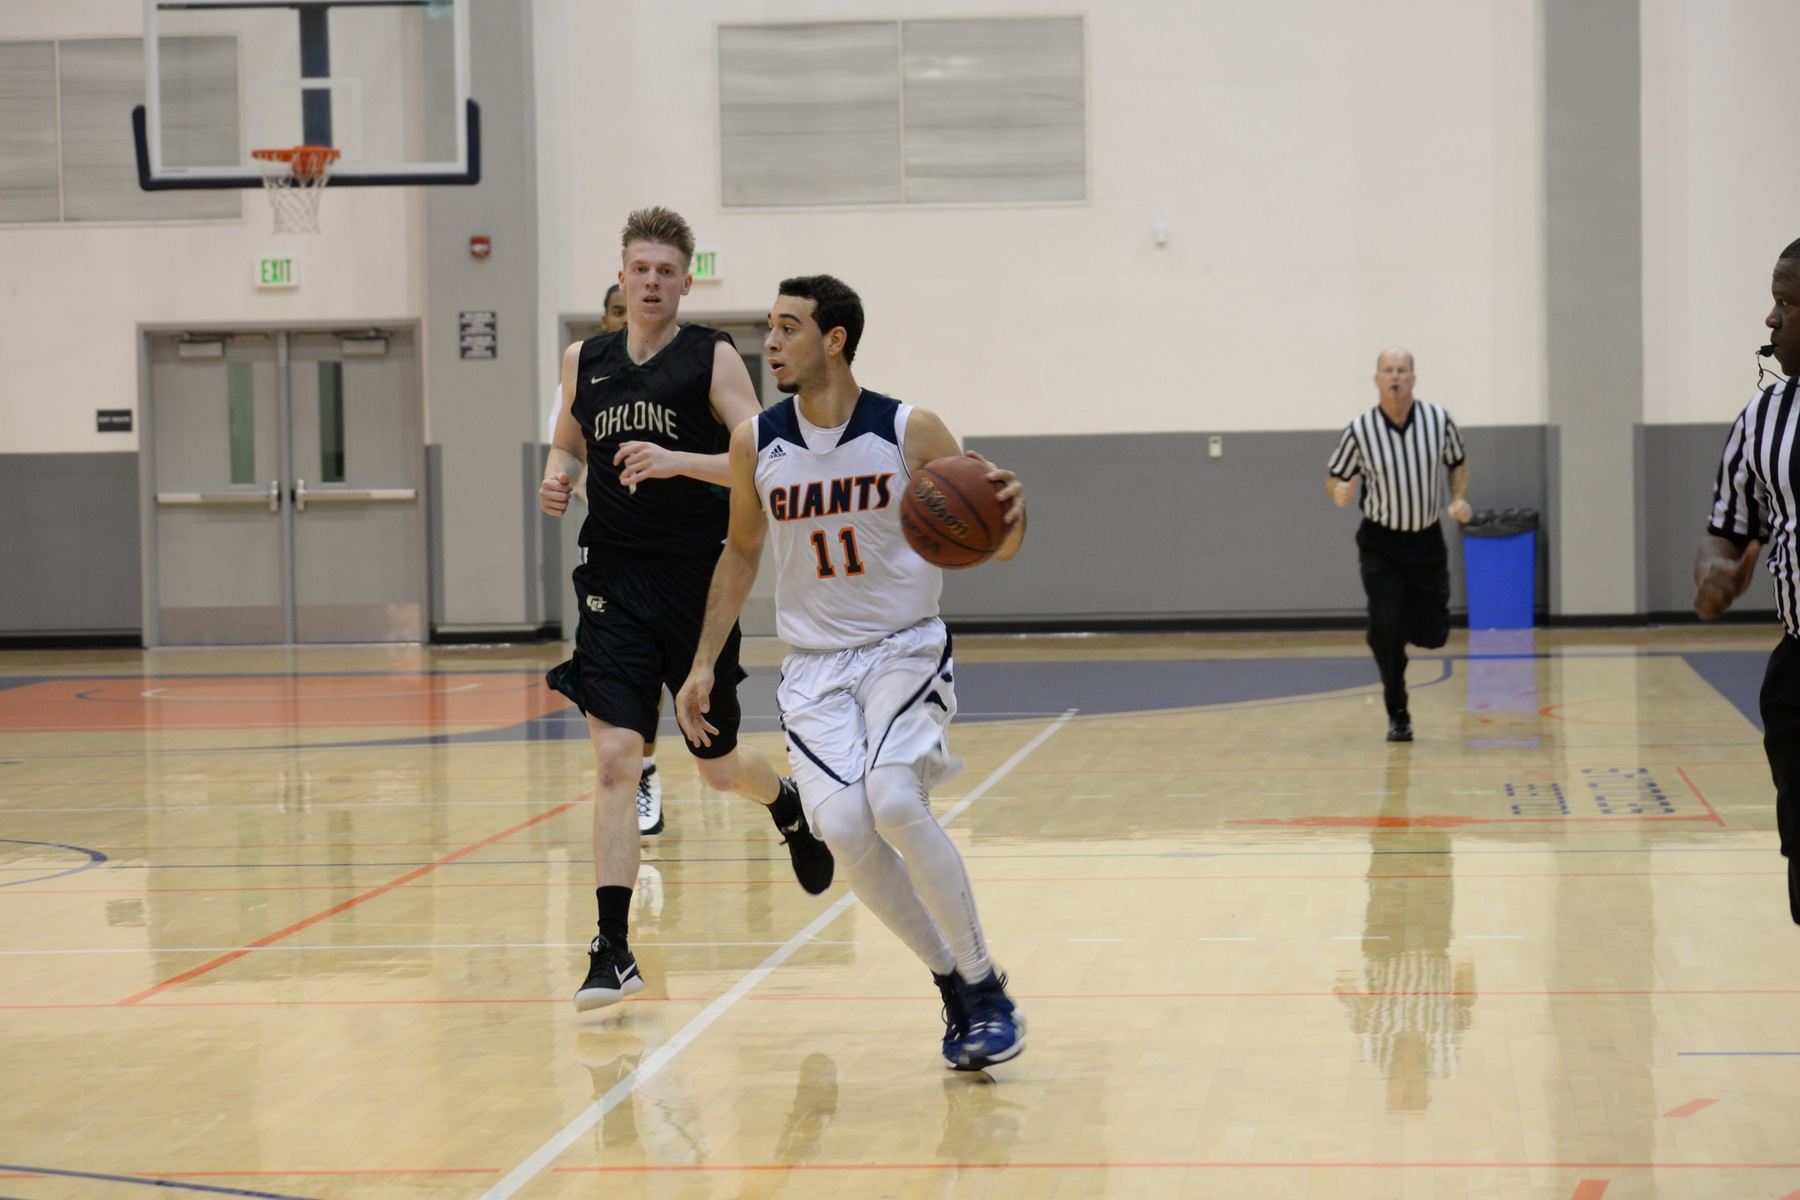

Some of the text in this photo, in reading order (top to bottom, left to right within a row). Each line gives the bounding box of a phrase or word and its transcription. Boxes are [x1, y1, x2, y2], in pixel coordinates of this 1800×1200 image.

[261, 259, 291, 283] EXIT
[594, 401, 679, 441] OHLONE
[769, 473, 895, 522] GIANTS
[810, 526, 865, 579] 11
